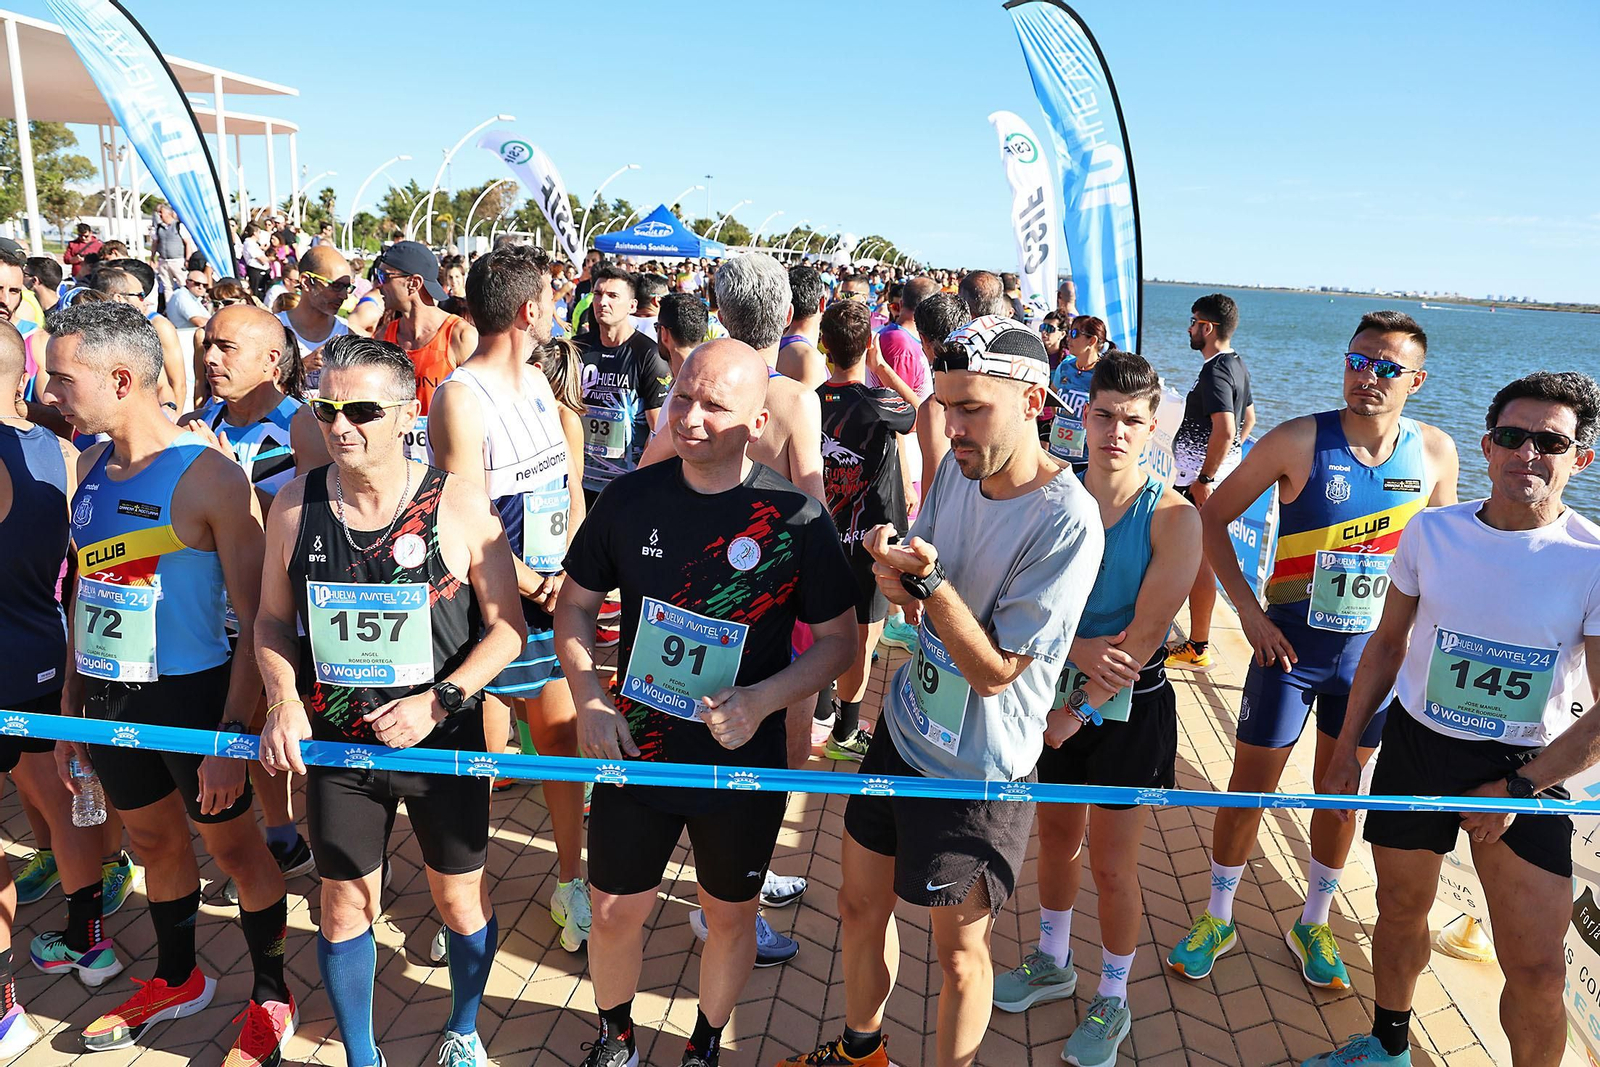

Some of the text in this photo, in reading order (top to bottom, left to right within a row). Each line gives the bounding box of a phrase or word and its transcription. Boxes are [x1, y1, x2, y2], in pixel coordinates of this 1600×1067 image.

[615, 241, 679, 252] Asistencia Sanitaria
[597, 372, 630, 388] HUELVA
[590, 419, 610, 436] 93
[1057, 427, 1073, 441] 52
[1328, 464, 1351, 472] mobel
[1228, 516, 1257, 548] uelva
[1342, 516, 1390, 540] CLUB
[86, 542, 126, 567] CLUB
[308, 554, 327, 562] BY2
[642, 546, 663, 558] BY2
[1331, 573, 1388, 598] 160
[98, 589, 125, 603] AVATEL
[125, 591, 149, 607] '24
[330, 590, 356, 600] HUELVA
[360, 591, 396, 601] AVATEL
[397, 590, 421, 605] '24
[85, 605, 122, 639] 72
[330, 611, 409, 642] 157
[686, 620, 718, 636] AVATEL
[1325, 614, 1368, 626] Wayalia
[661, 635, 707, 676] 91
[1457, 640, 1483, 653] HUELVA
[1486, 647, 1526, 662] AVATEL
[1528, 652, 1551, 667] '24
[333, 665, 387, 679] Wayalia
[917, 647, 939, 694] 89
[1450, 659, 1533, 700] 145
[669, 678, 685, 688] PEDRO
[641, 682, 687, 710] Wayalia
[1440, 707, 1497, 731] Wayalia
[1457, 706, 1508, 719] PEREZ RODRIGUEZ
[1439, 874, 1473, 896] ELVA
